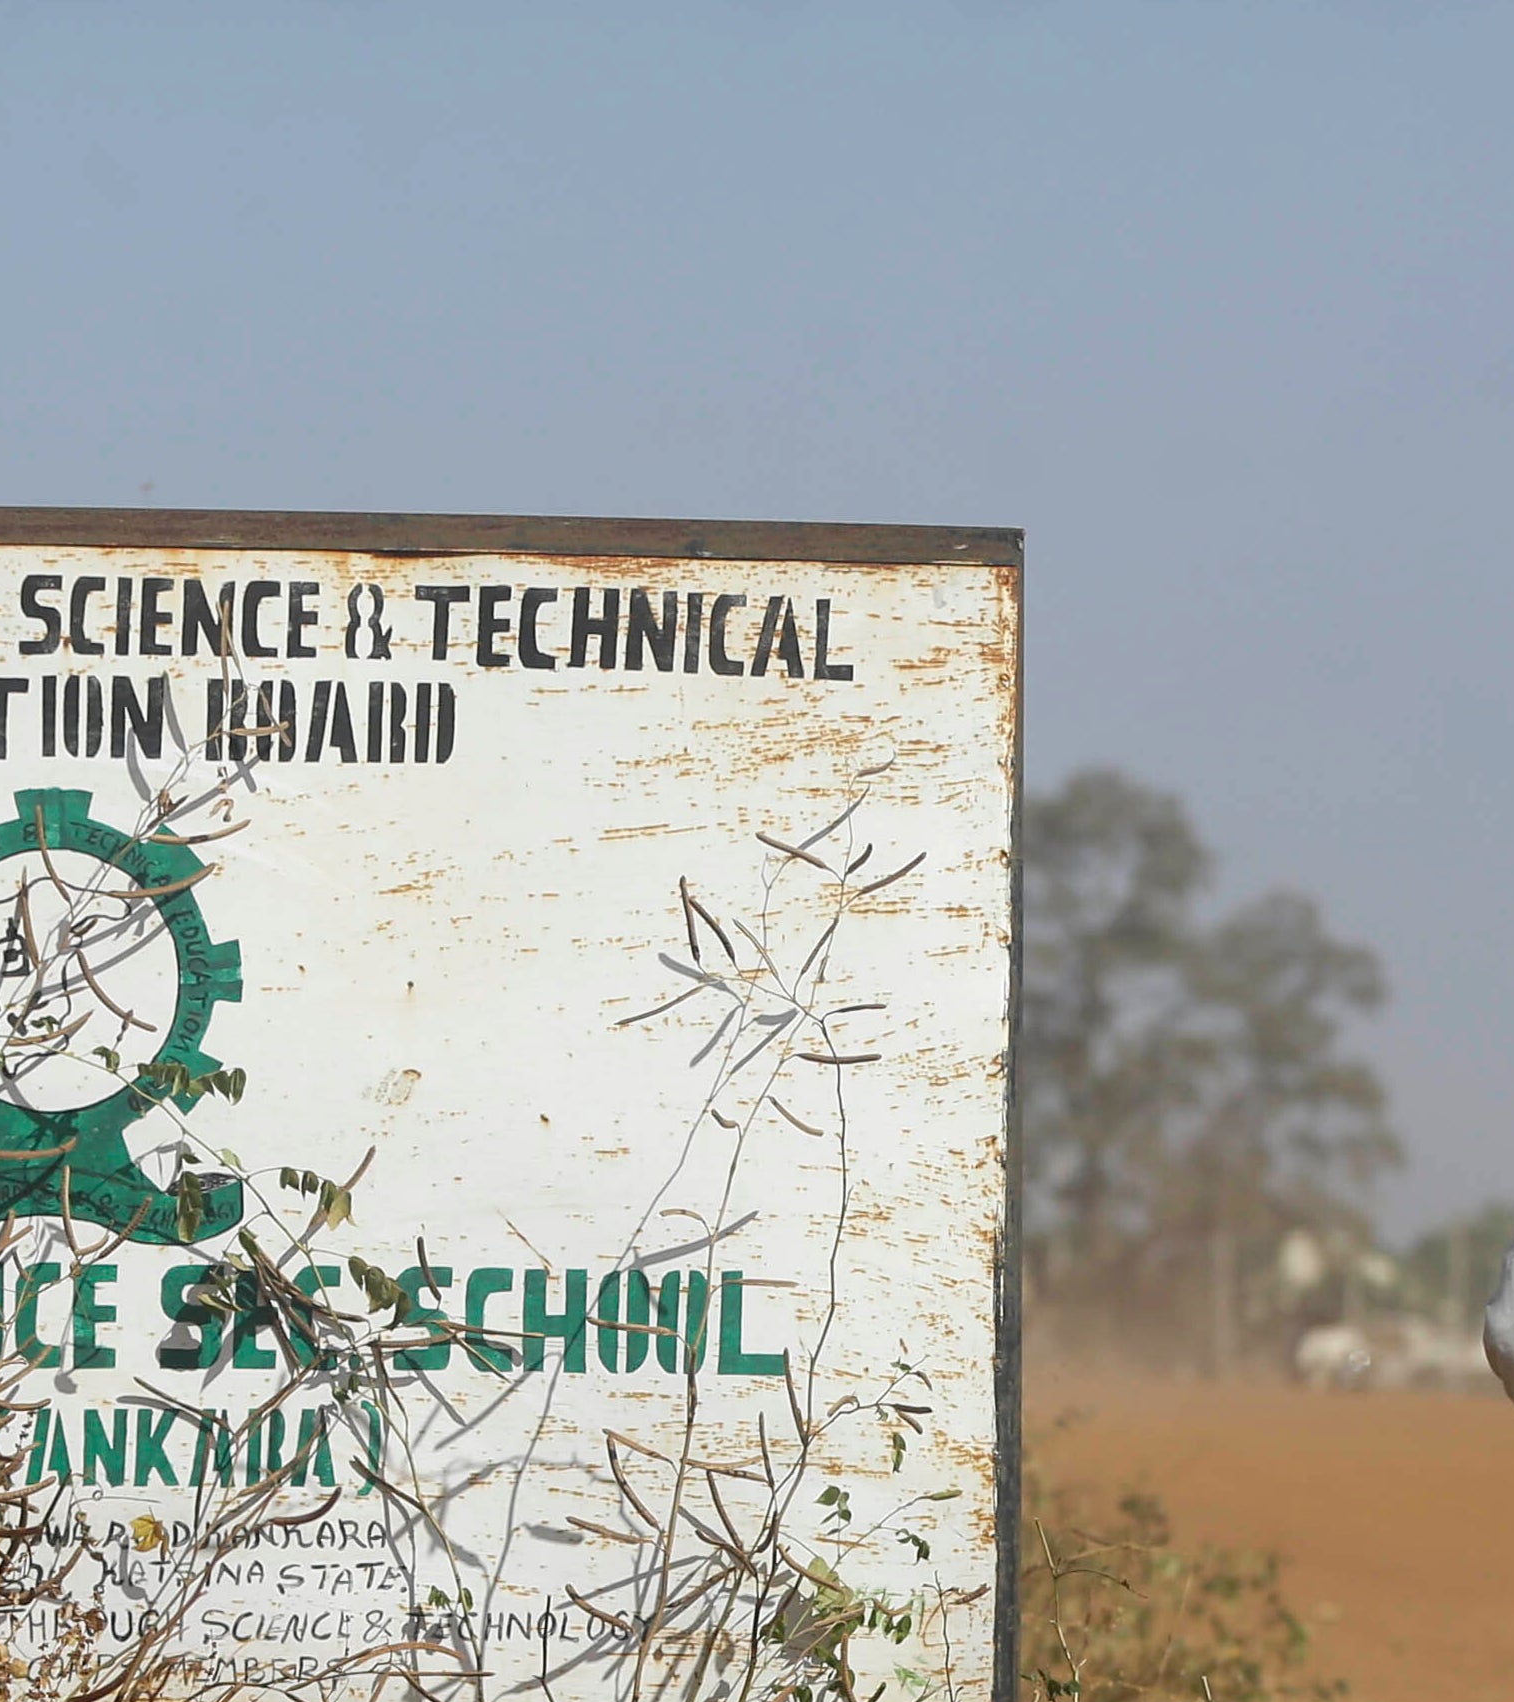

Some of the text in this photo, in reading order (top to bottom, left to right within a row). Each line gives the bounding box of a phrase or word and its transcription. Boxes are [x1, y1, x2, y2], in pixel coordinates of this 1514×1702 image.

[20, 574, 321, 660] SCIENCE
[346, 582, 393, 660] &
[407, 583, 855, 681] TECHNICAL
[205, 678, 456, 764] BOARD
[70, 820, 177, 894] TECHNICA
[172, 909, 213, 1054] EDUCATION
[392, 1265, 789, 1378] SCHOOL
[202, 1608, 351, 1645] SCIENCE
[363, 1610, 393, 1644] &
